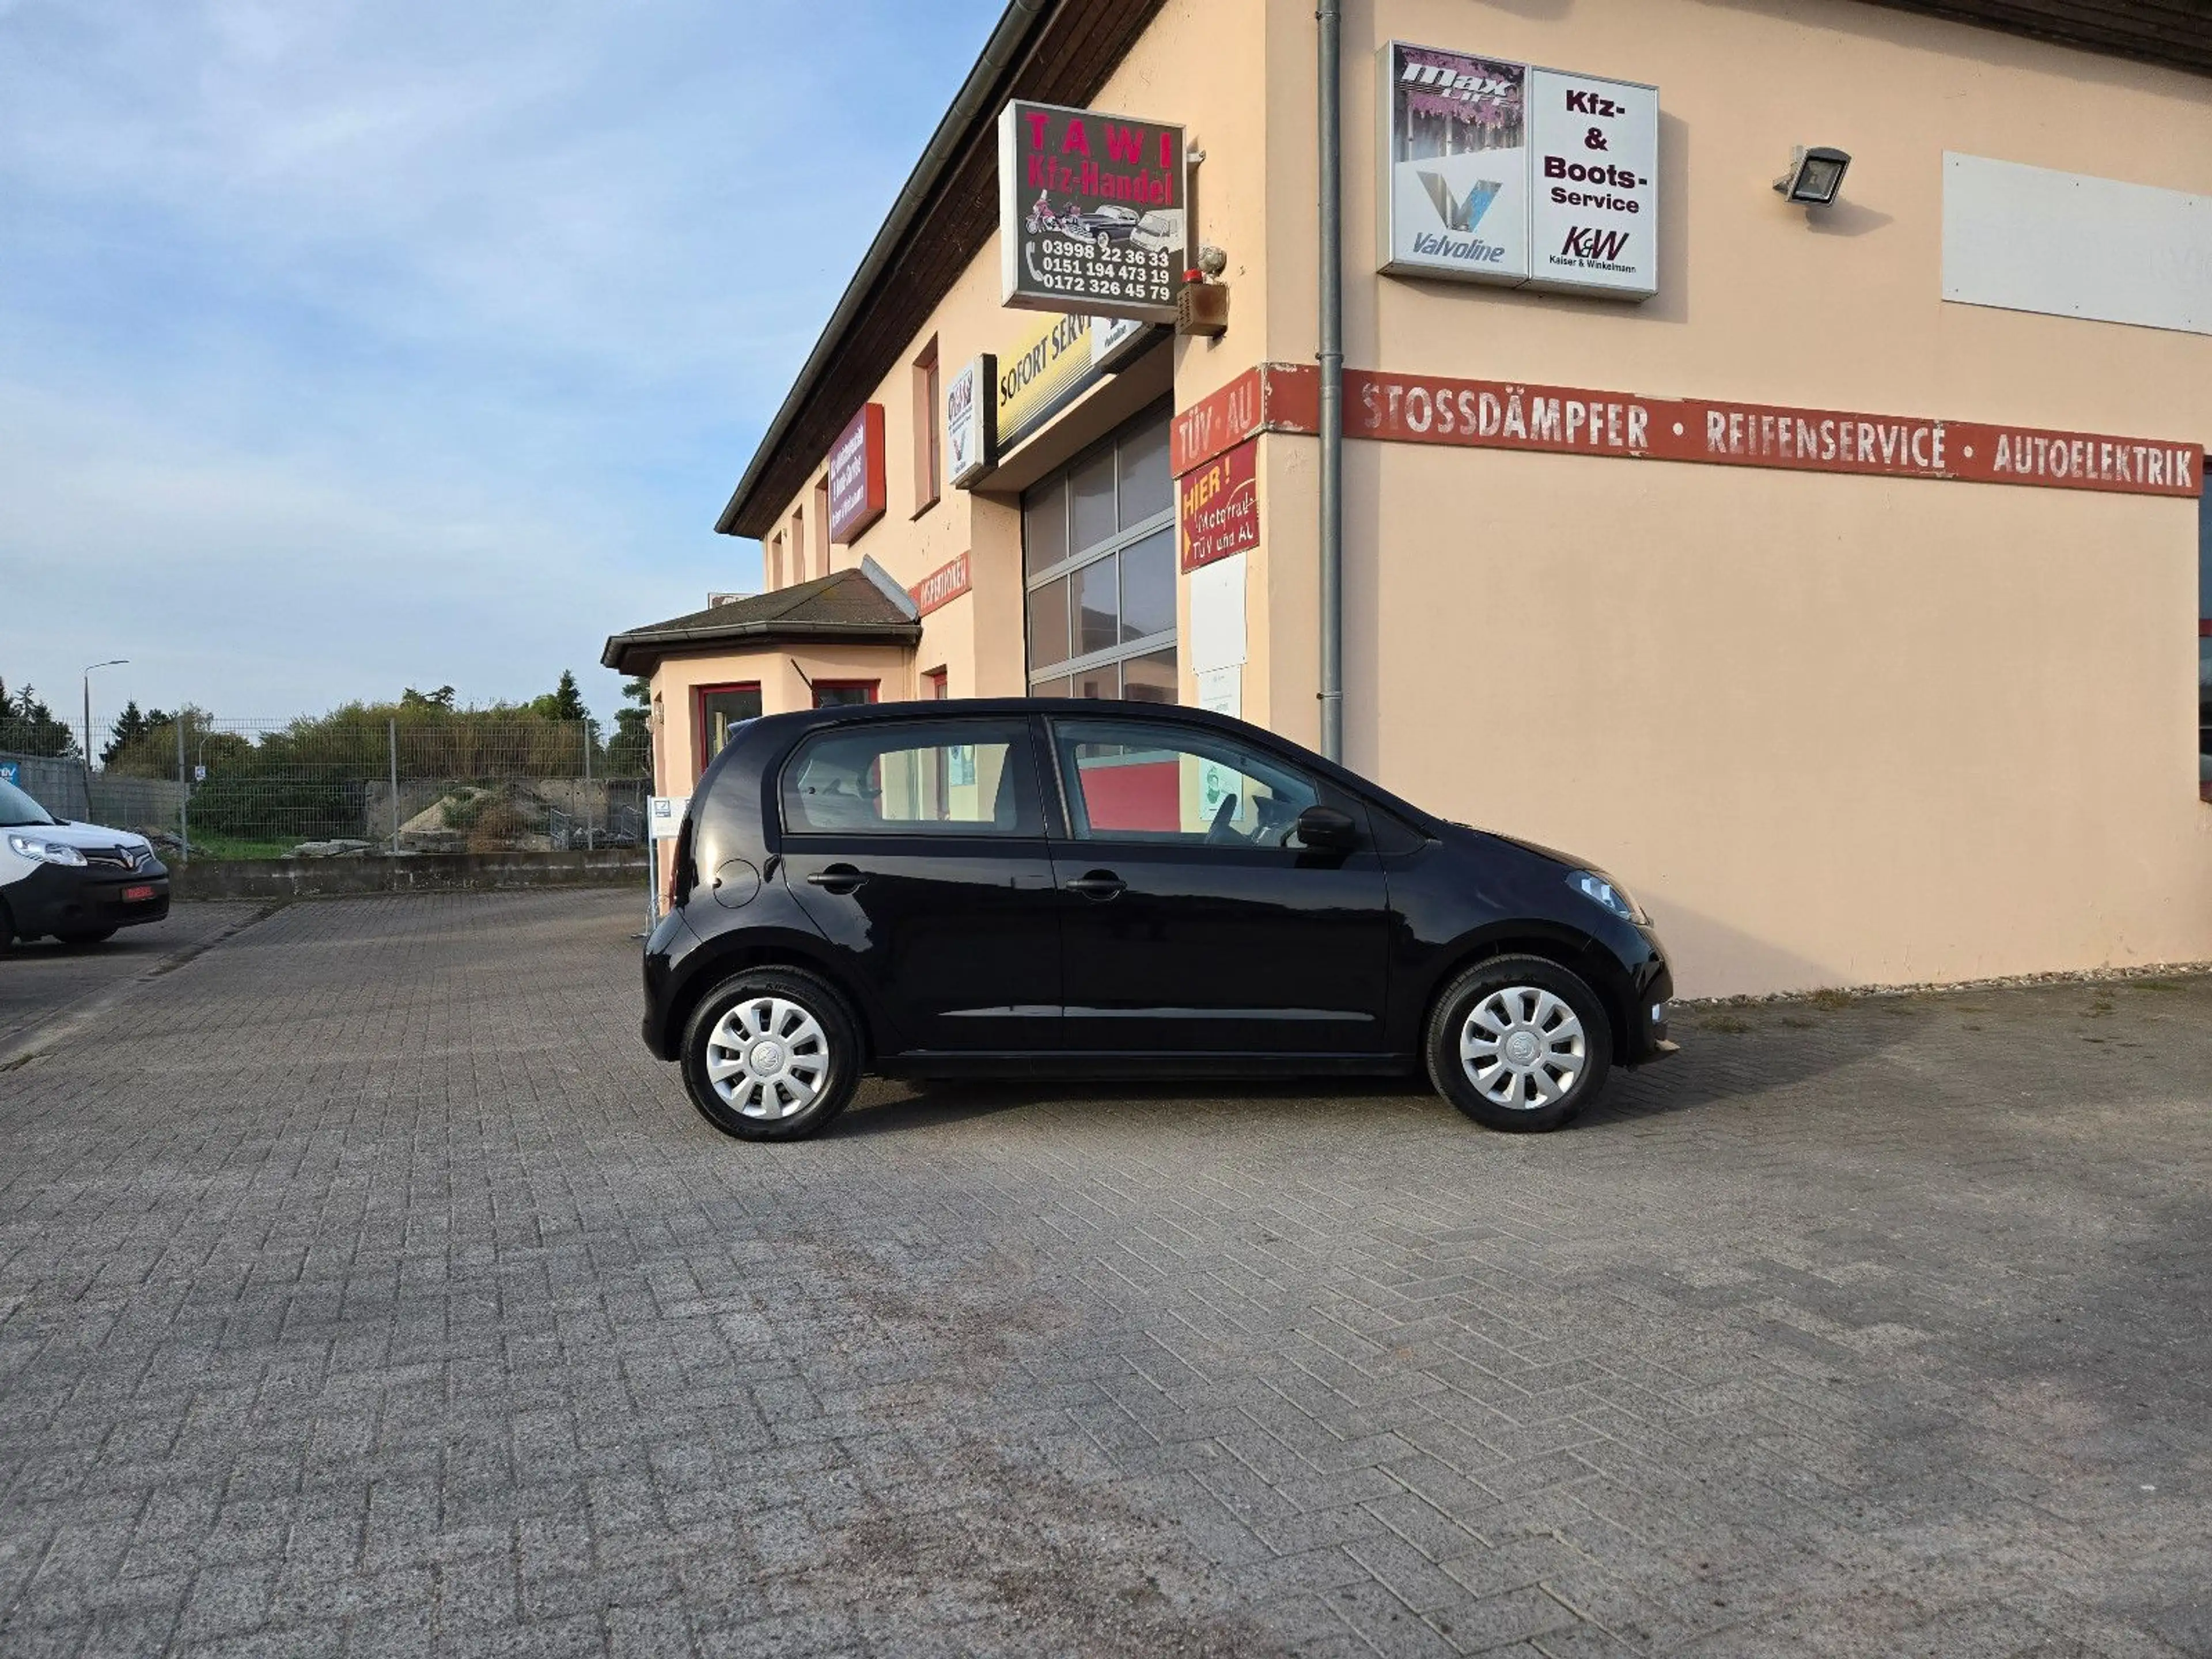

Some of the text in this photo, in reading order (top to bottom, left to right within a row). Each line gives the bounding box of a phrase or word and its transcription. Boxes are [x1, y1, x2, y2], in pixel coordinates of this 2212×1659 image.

[1566, 89, 1626, 118] Kfz-
[1585, 127, 1608, 151] &
[1028, 154, 1173, 206] Kfz-Handel
[1544, 155, 1647, 189] Boots-
[1551, 186, 1639, 214] Service
[1042, 239, 1169, 267] 03998 22 36 33
[1412, 232, 1505, 263] Valvoline
[1043, 257, 1169, 284] 0151 194 473 19
[1550, 255, 1637, 273] Kaiser & Winkelmann
[1043, 274, 1170, 301] 0172 326 45 79
[1001, 336, 1048, 407] SOFORT
[1179, 380, 1252, 465] TÜV AU
[1361, 382, 1649, 448] STOSSDÄMPFER
[1707, 410, 1945, 468] REIFENSERVICE
[1993, 434, 2192, 487] AUTOELEKTRIK
